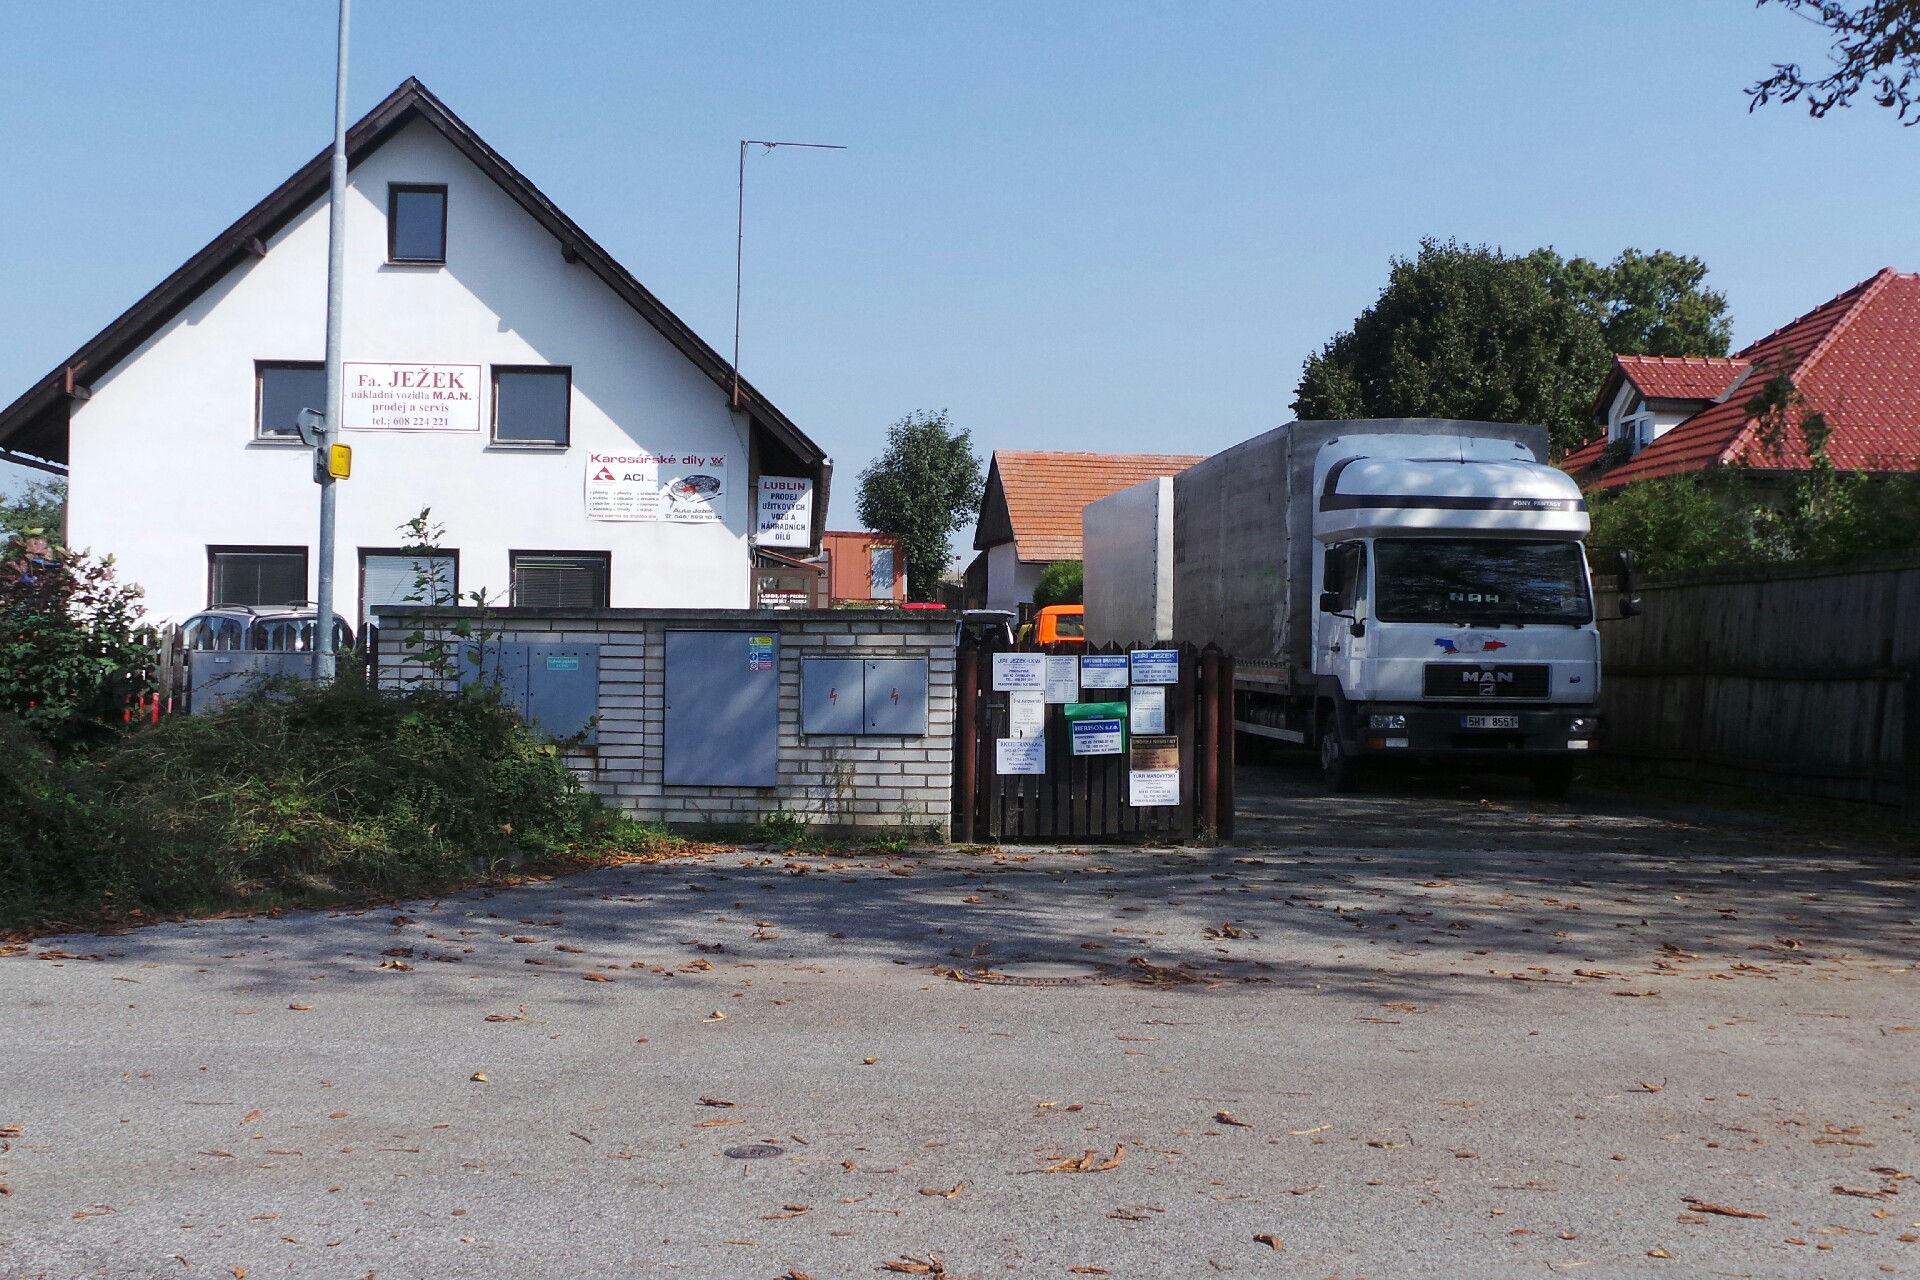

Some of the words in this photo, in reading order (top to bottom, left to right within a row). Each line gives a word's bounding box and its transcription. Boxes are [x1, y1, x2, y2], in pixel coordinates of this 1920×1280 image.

[358, 374, 382, 387] Fa.
[388, 367, 465, 389] JEŽEK
[351, 390, 394, 400] nákladní
[396, 391, 430, 401] vozidla
[433, 391, 473, 401] M.A.N.
[372, 402, 407, 414] prodej
[410, 404, 417, 412] a
[419, 403, 450, 412] servis
[393, 417, 411, 426] 608
[413, 418, 430, 426] 224
[433, 418, 449, 426] 221
[591, 453, 677, 465] Karosářské
[682, 455, 706, 468] díly
[623, 473, 645, 482] ACI
[763, 482, 806, 491] LUBLIN
[771, 493, 798, 501] PRODEJ
[762, 501, 805, 511] UŽITKOVÝCH
[771, 511, 789, 521] VOZŮ
[761, 521, 806, 531] NÁHRADNÍCH
[775, 531, 791, 541] DÍLŮ
[1462, 671, 1513, 683] MAN
[1468, 716, 1486, 727] 5H1
[1491, 717, 1515, 727] 8551
